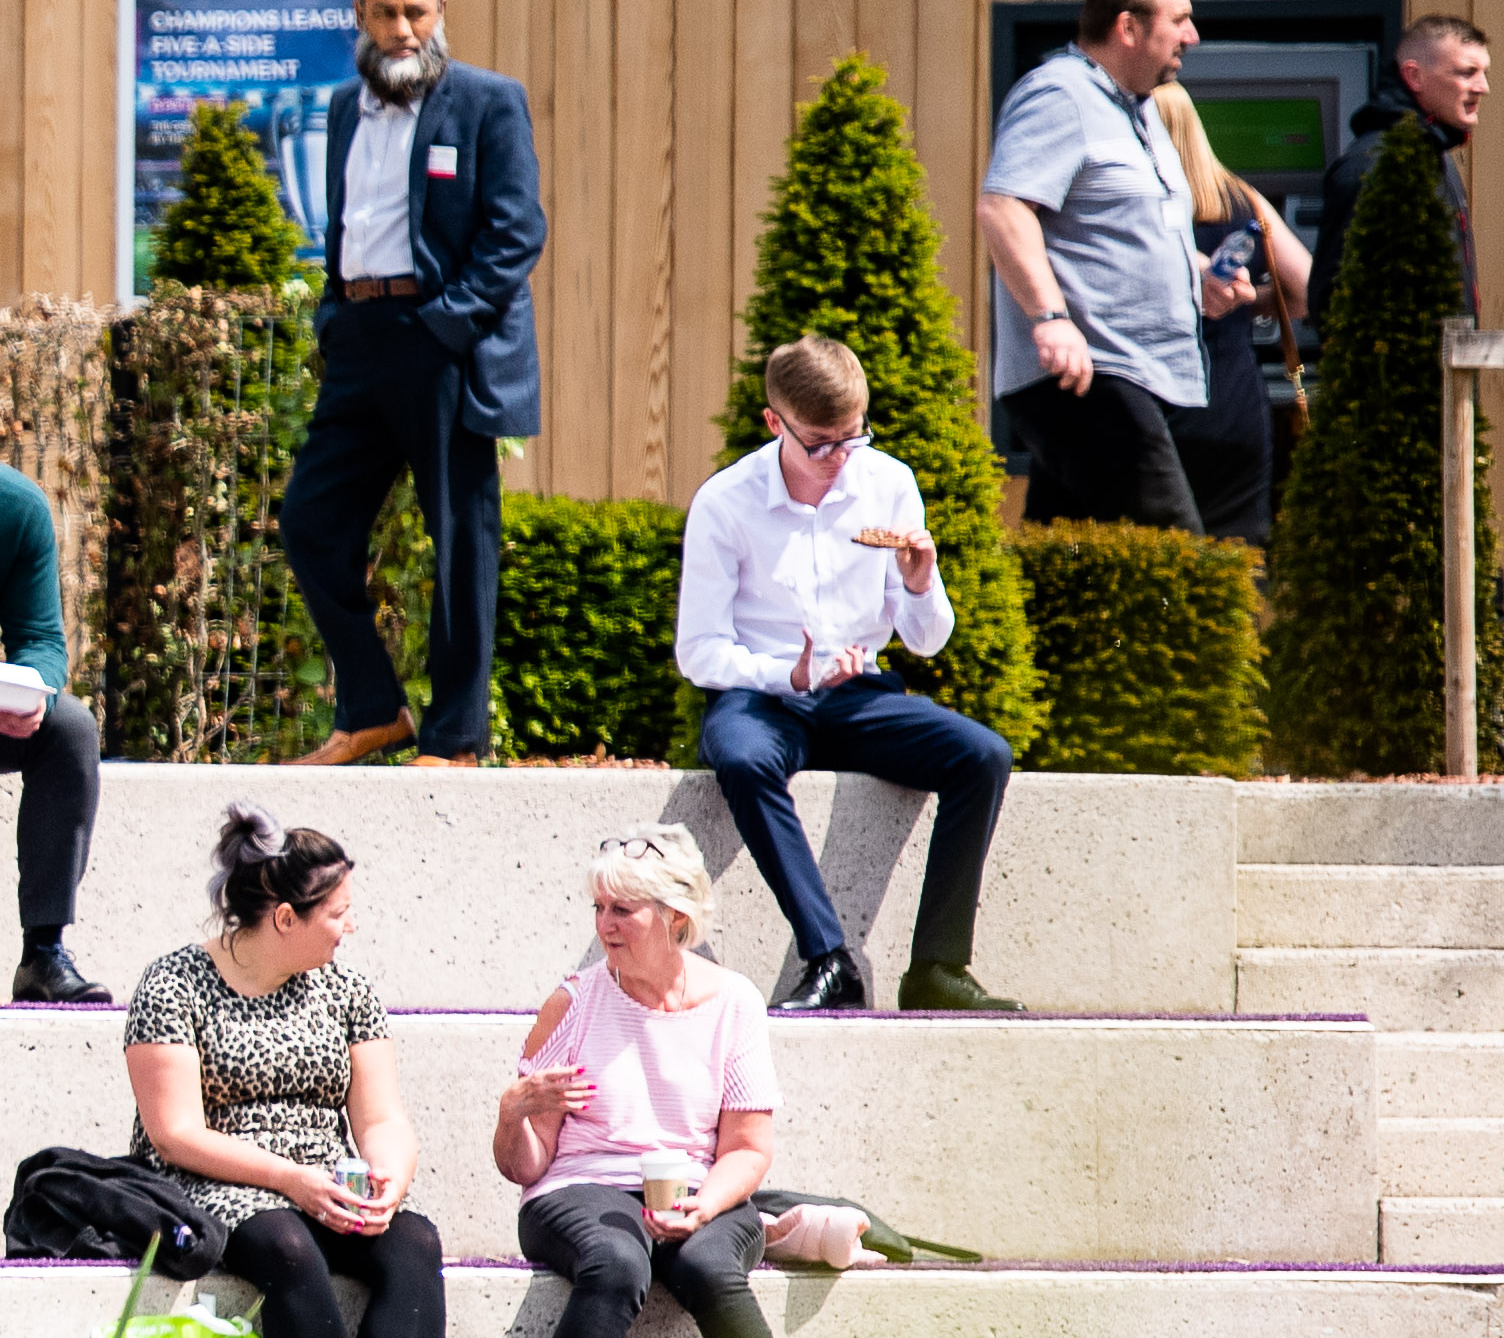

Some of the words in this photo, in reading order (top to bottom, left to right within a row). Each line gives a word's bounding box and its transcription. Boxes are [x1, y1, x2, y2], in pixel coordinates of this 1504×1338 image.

[149, 10, 280, 32] CHAMPIONS
[282, 8, 359, 31] LEAGU
[150, 59, 301, 82] TOURNAMENT
